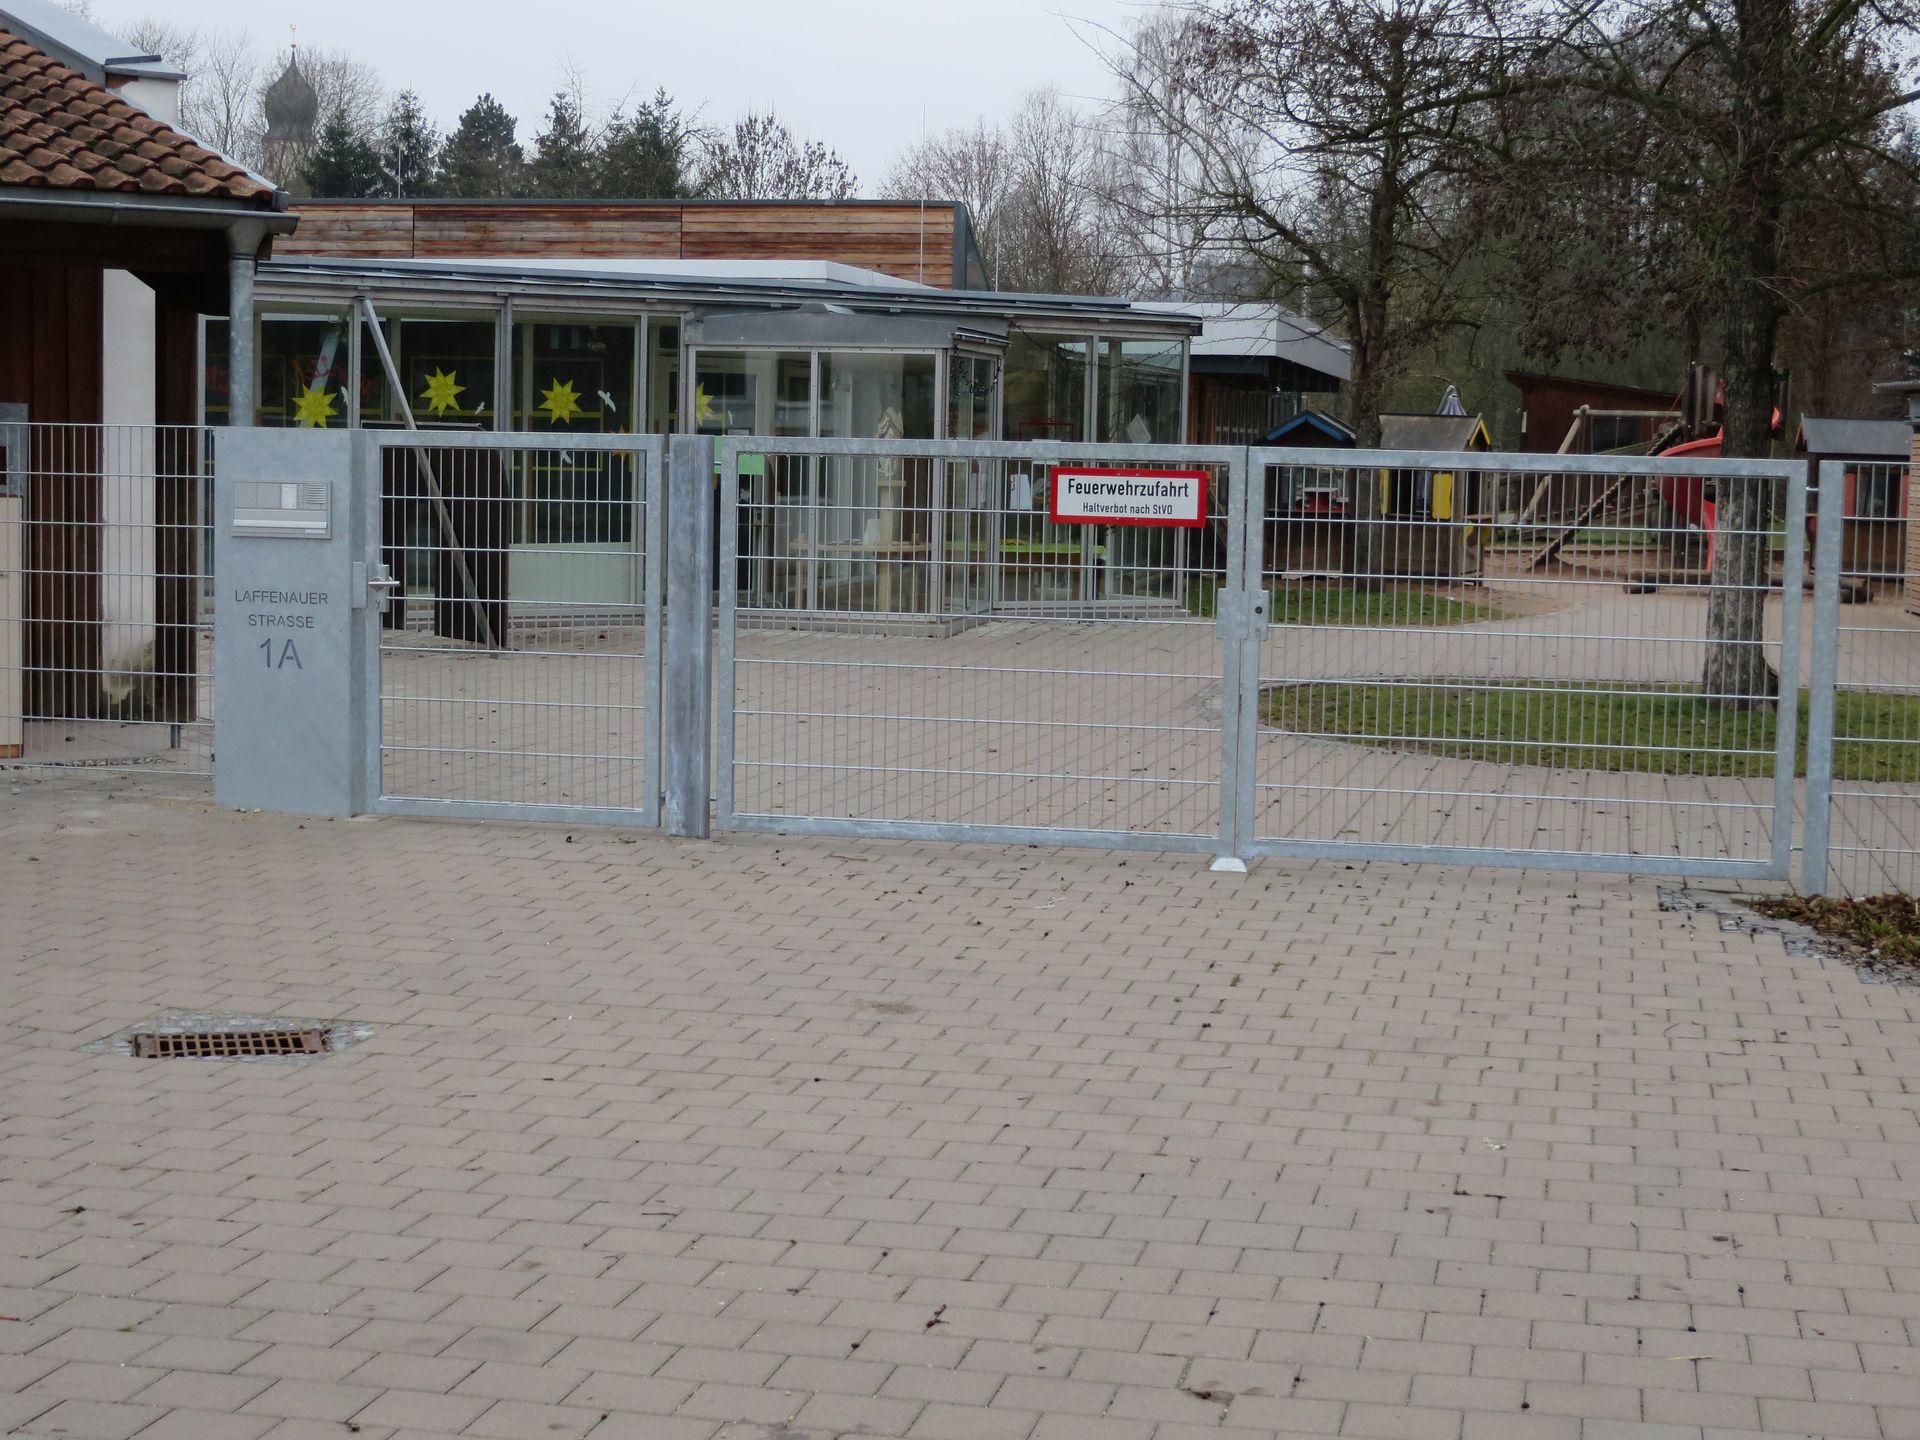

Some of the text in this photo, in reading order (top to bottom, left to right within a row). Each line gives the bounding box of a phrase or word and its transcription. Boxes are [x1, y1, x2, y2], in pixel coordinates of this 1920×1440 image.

[1068, 478, 1189, 498] Feuerwehrzufahrt
[1083, 502, 1173, 515] Haltverbot nach StVO
[234, 590, 328, 605] LAFFENAUER
[248, 614, 315, 628] STRASSE
[260, 638, 303, 670] 1A
